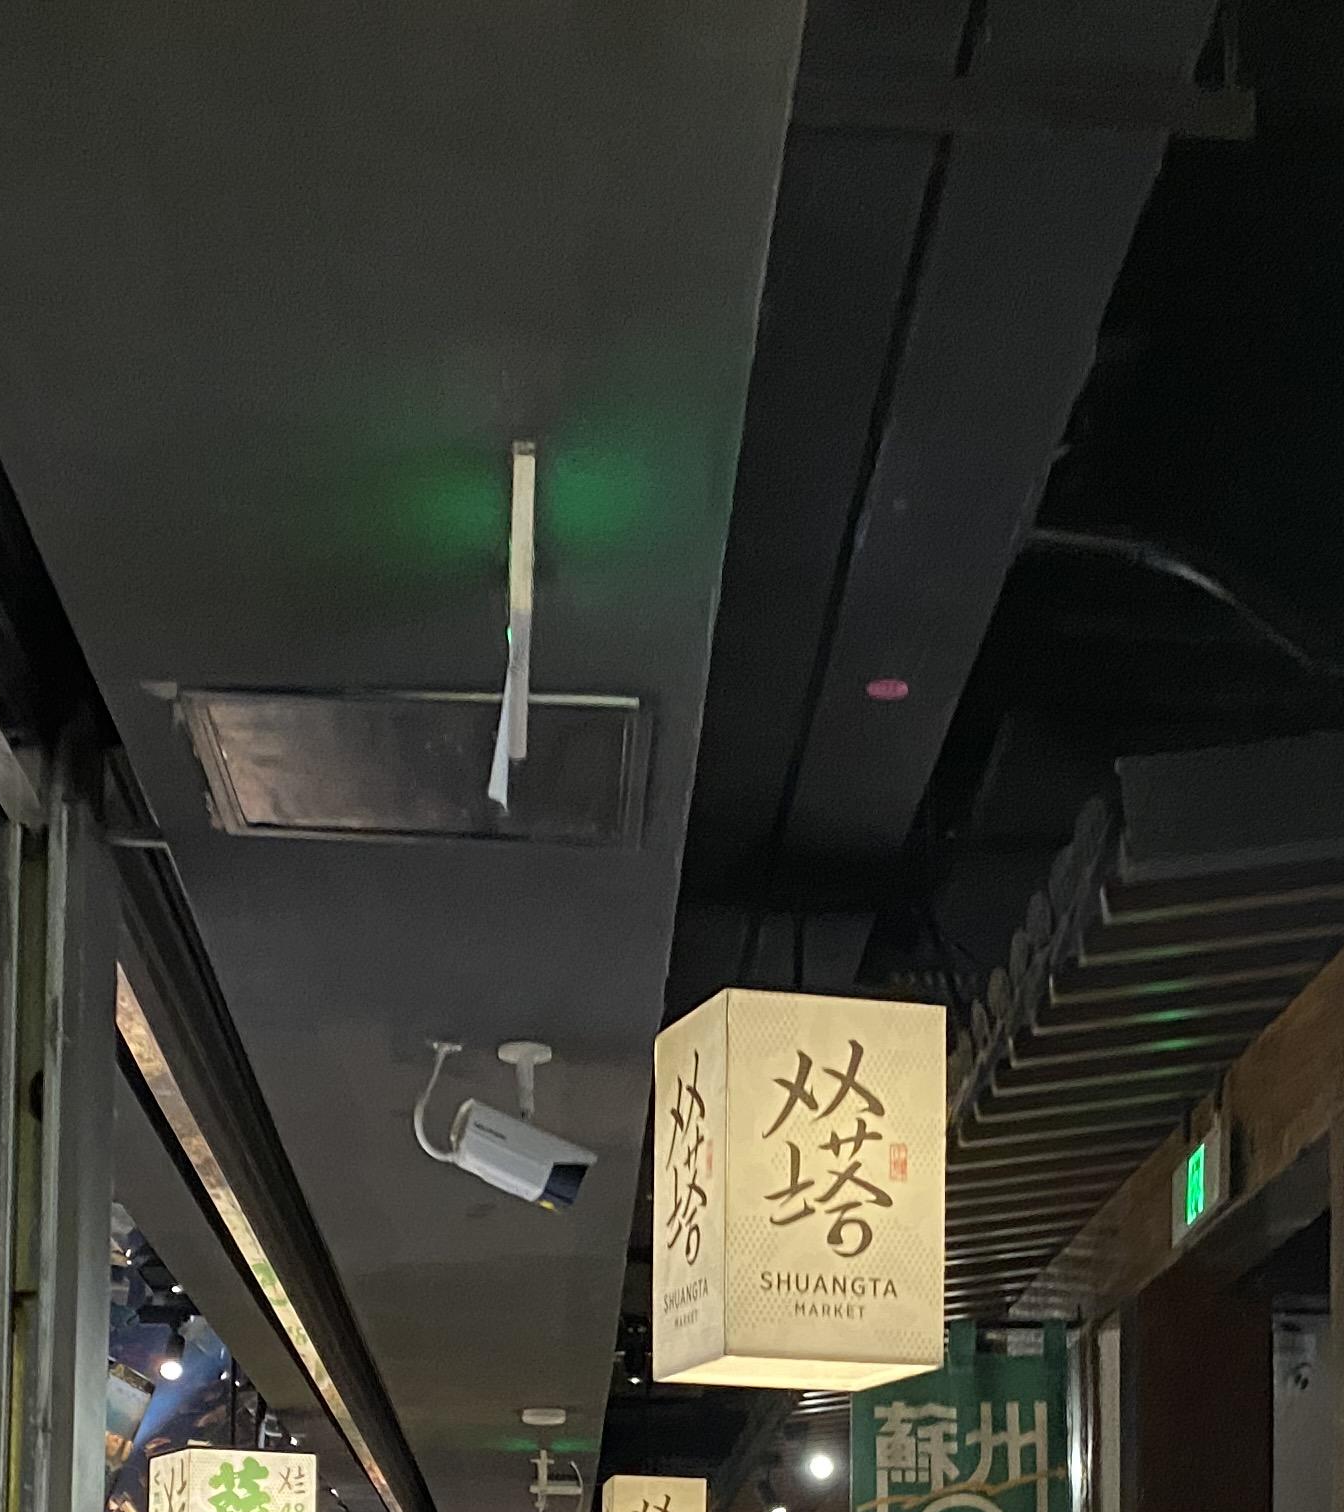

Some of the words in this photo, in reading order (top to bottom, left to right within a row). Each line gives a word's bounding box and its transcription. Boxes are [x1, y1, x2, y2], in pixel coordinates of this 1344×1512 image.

[663, 1276, 709, 1312] SHUANGTA
[760, 1271, 898, 1299] SHUANGTA
[794, 1302, 866, 1321] MARKET
